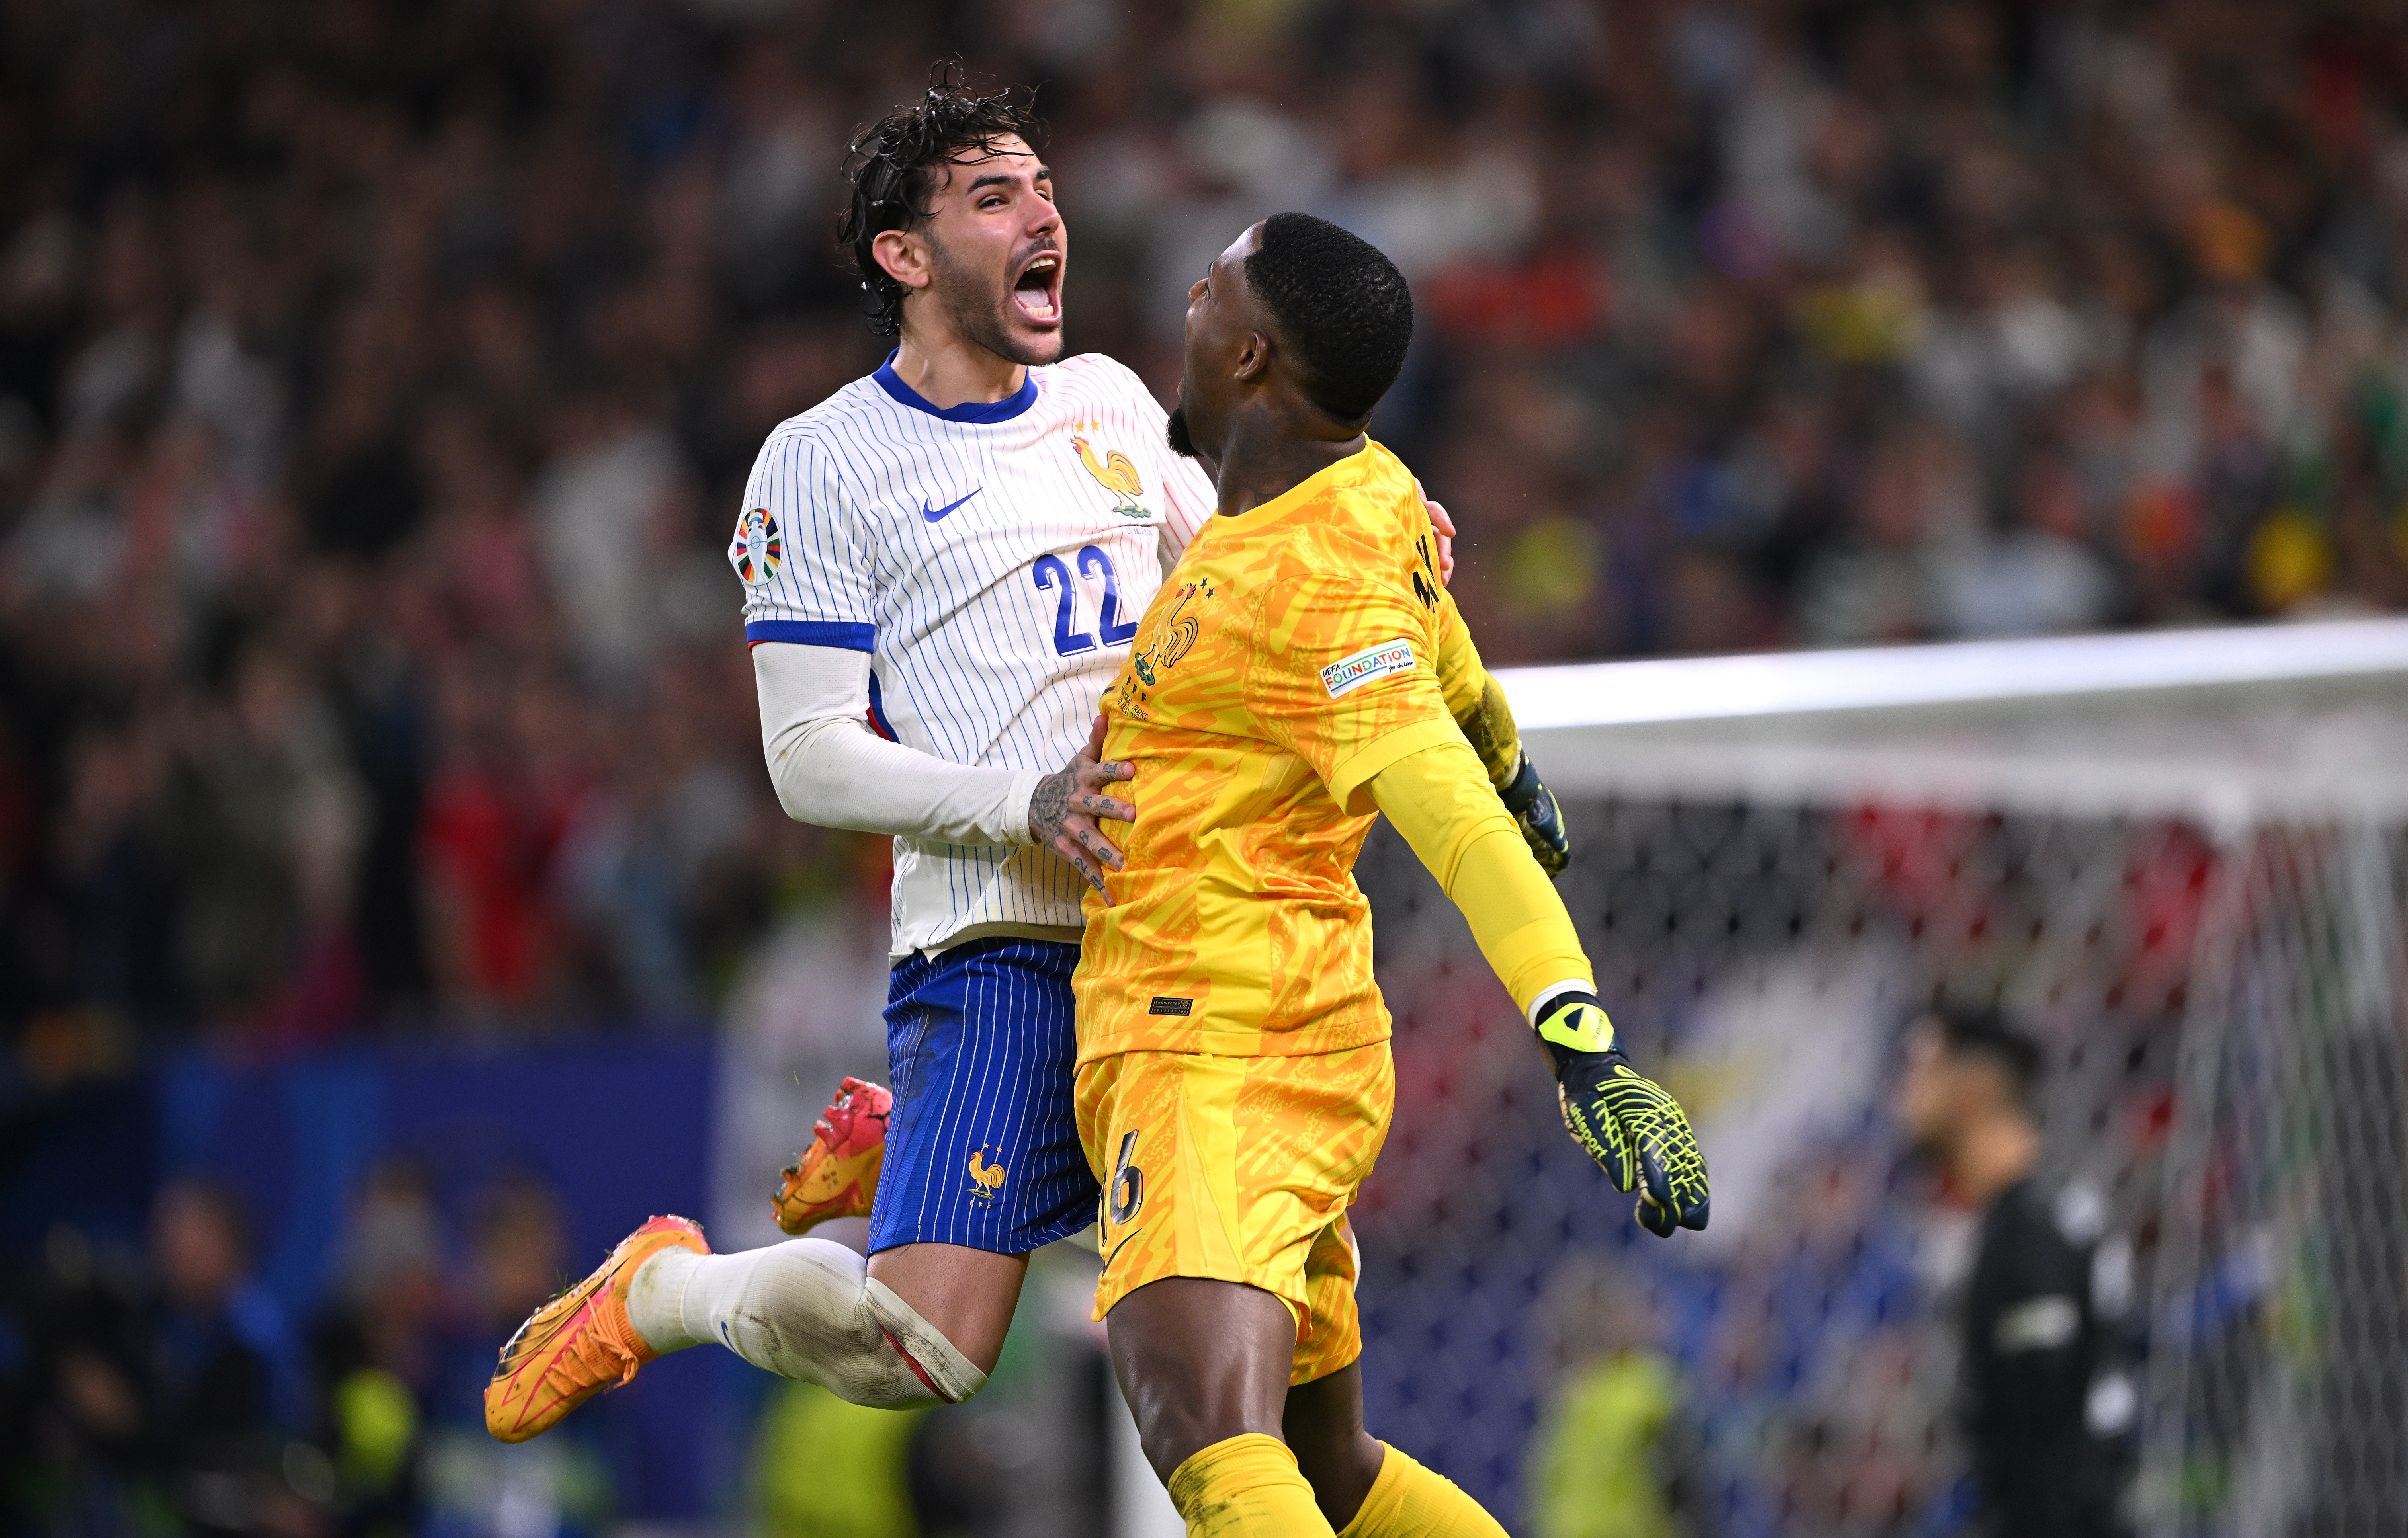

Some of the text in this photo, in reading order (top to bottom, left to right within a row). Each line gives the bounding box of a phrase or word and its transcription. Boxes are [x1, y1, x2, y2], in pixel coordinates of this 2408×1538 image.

[1032, 545, 1140, 657] 22
[1323, 664, 1341, 677] UEFA
[1325, 648, 1411, 688] FOUNDATION
[1132, 704, 1148, 721] FRANCE
[1570, 1102, 1609, 1160] uhlsport
